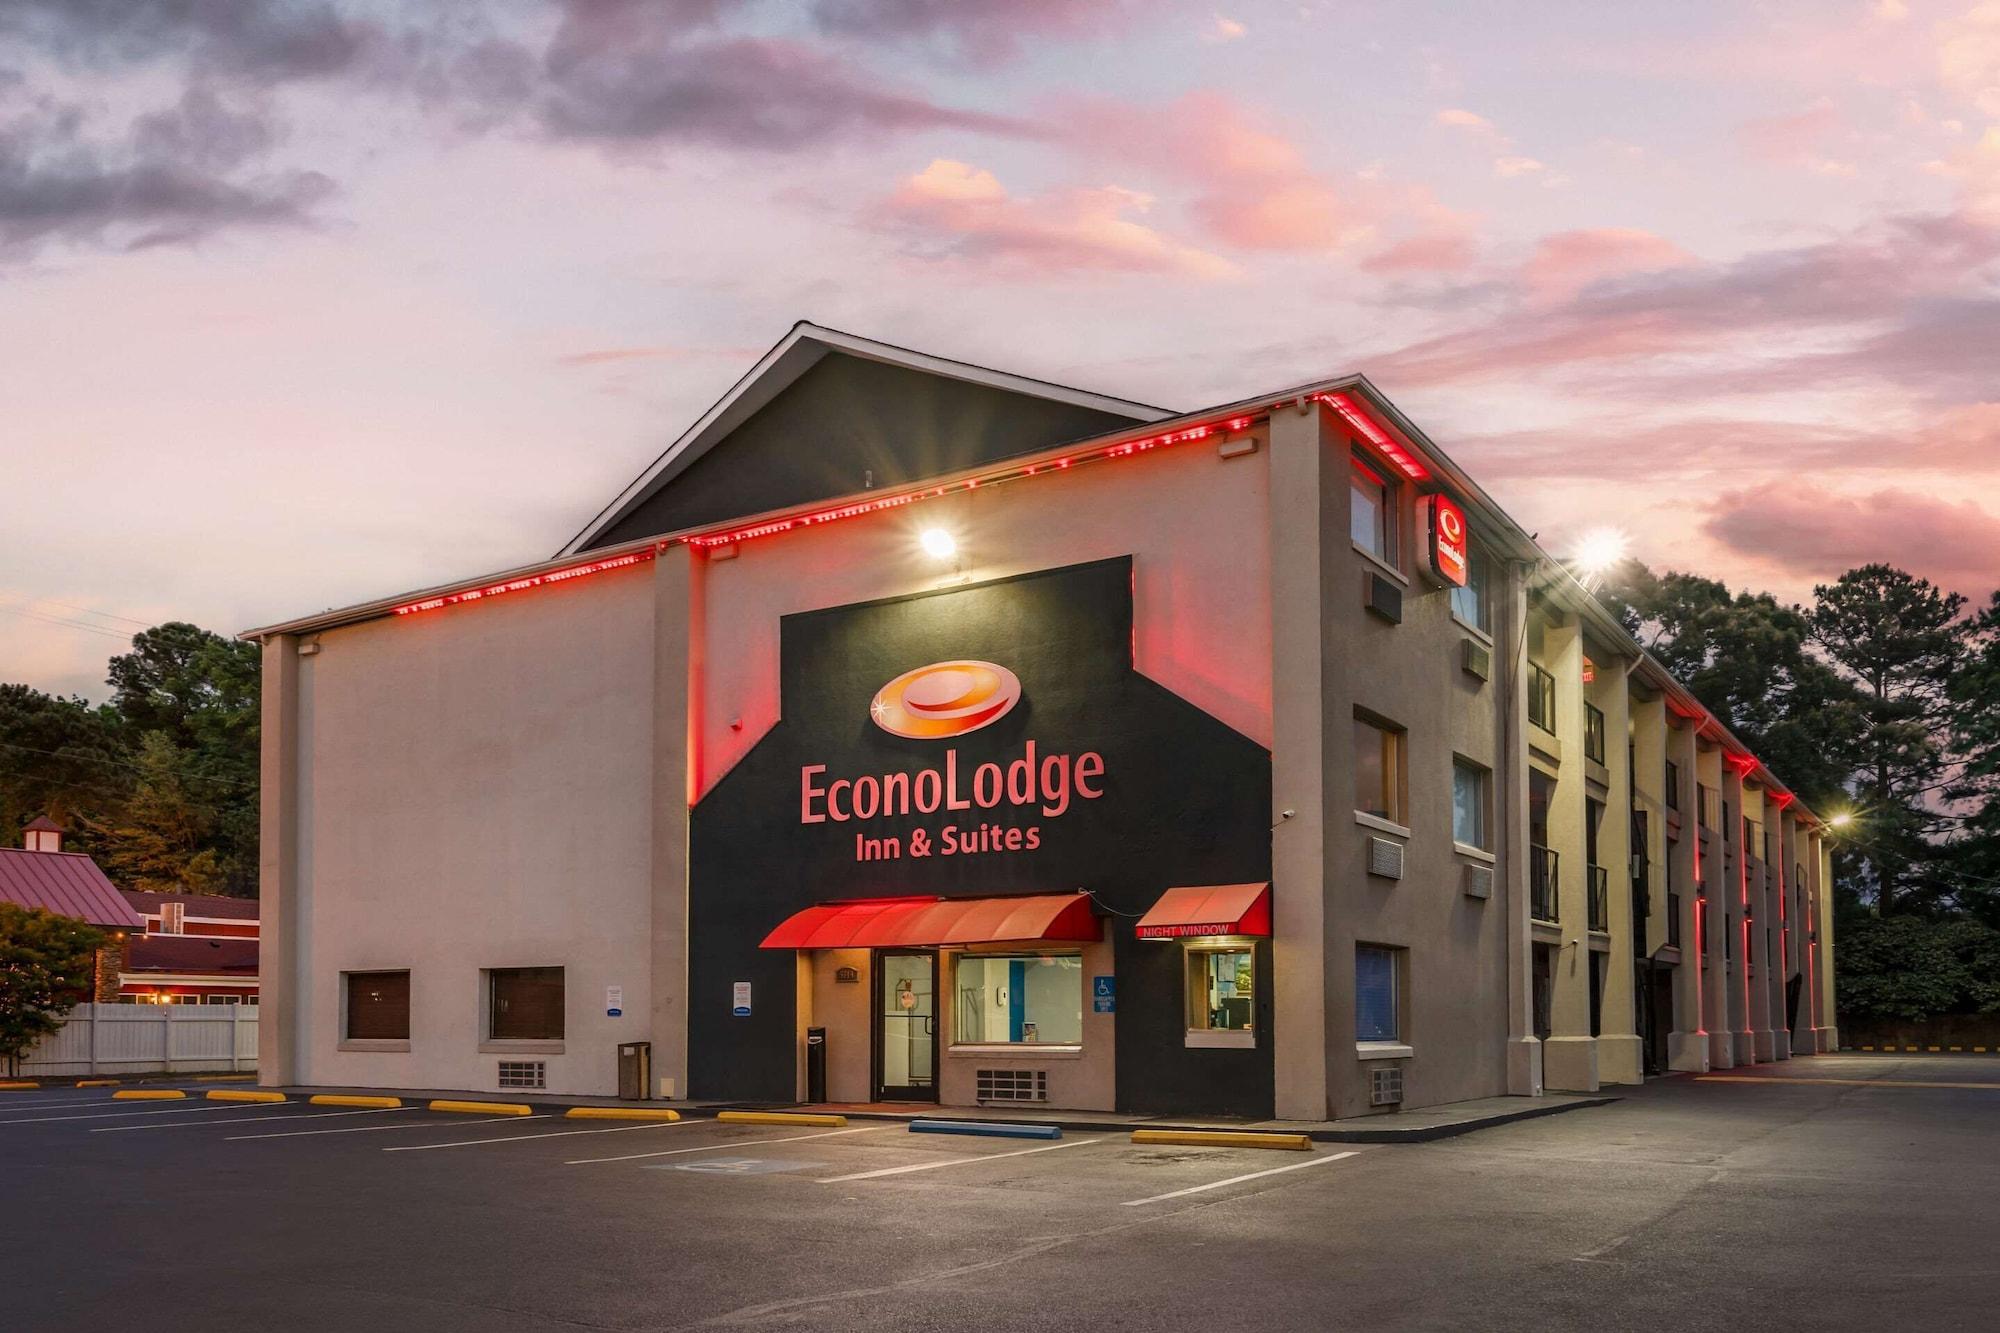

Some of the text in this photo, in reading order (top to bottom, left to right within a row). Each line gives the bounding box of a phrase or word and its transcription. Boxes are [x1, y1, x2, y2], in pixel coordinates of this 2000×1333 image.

[801, 740, 1105, 824] EconoLodge
[856, 823, 1041, 862] Inn & Suites
[1143, 924, 1229, 937] NIGHT WINDOW
